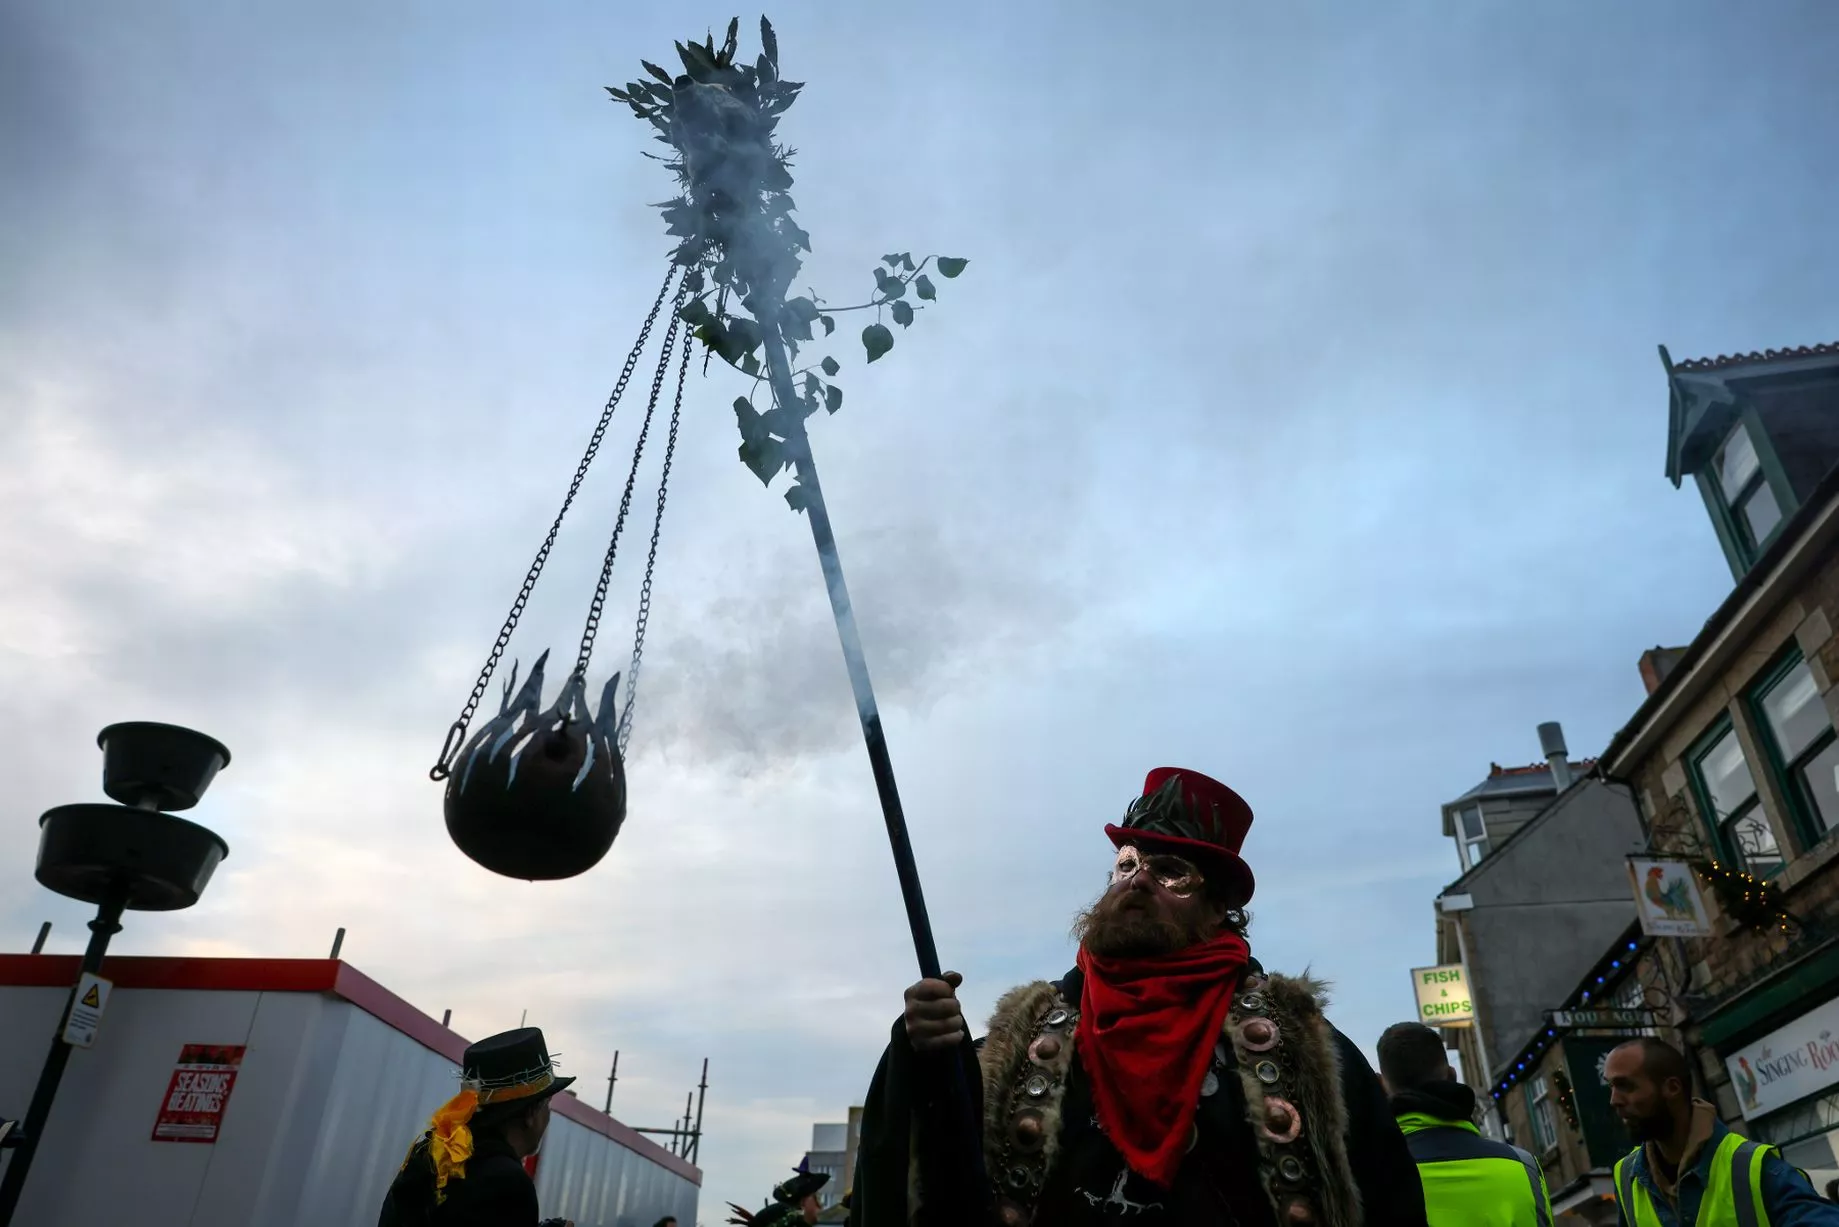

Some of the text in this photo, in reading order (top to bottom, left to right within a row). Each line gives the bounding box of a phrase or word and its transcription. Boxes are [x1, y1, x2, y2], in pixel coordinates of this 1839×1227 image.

[1423, 970, 1460, 984] FISH
[1441, 988, 1448, 997] &
[1423, 1000, 1473, 1016] CHIPS
